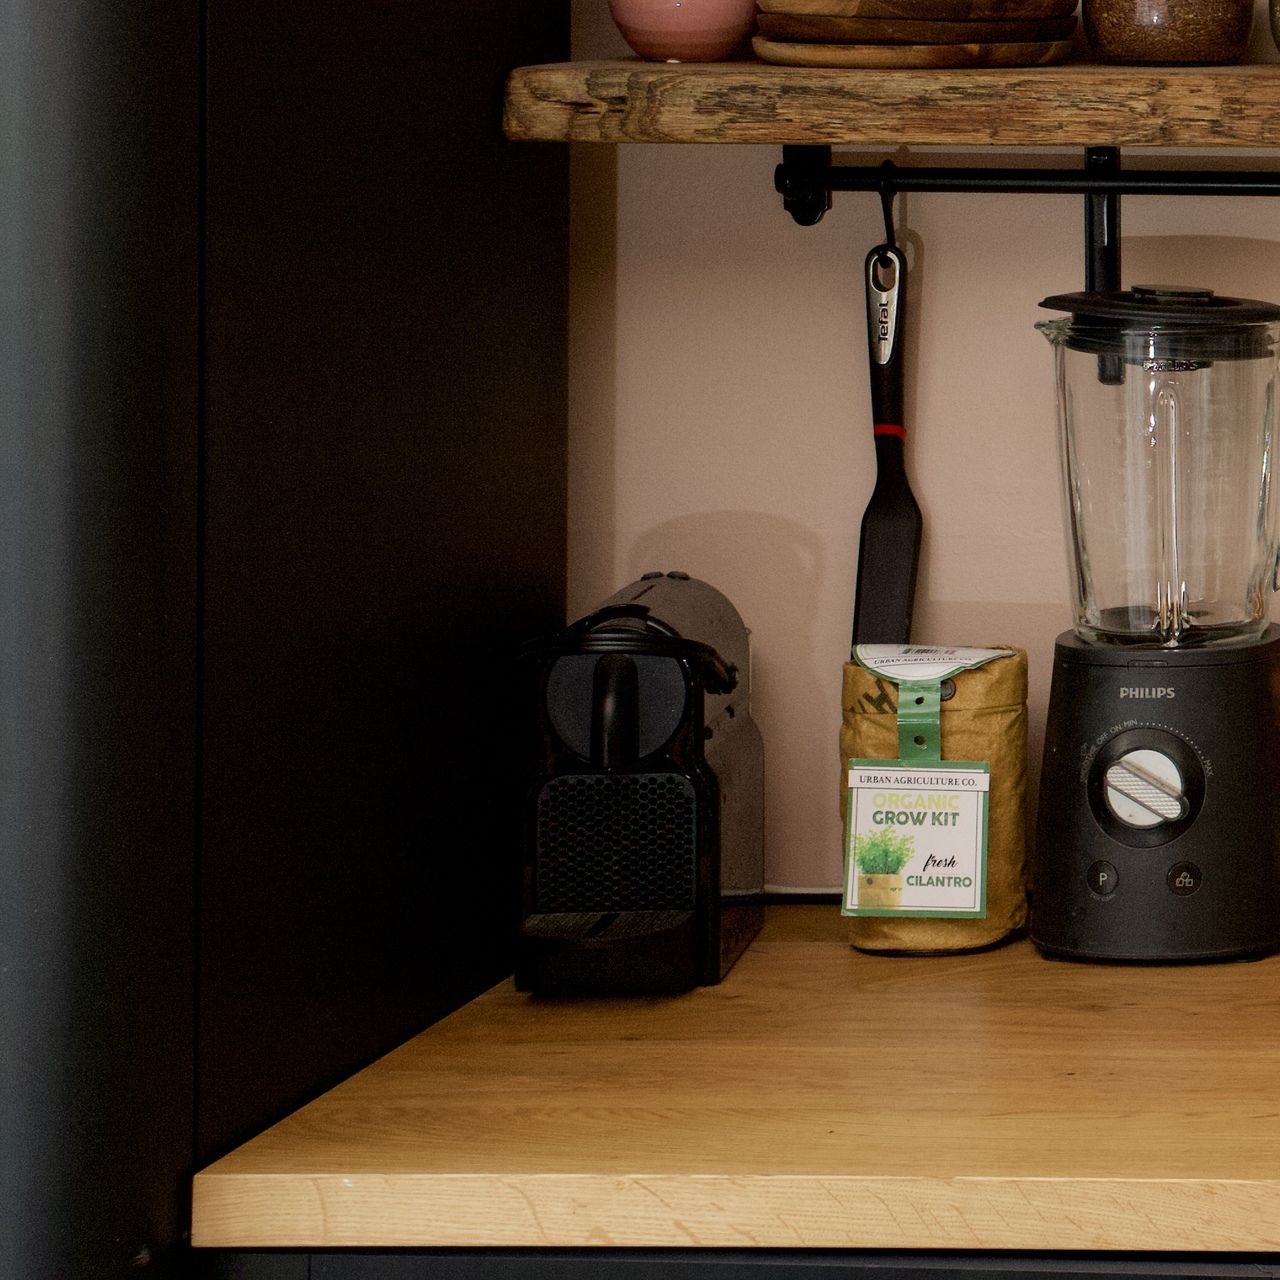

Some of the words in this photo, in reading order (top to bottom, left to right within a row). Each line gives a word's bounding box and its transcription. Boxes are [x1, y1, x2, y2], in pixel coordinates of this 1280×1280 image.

[878, 300, 889, 344] Tefal
[1119, 687, 1176, 699] PHILIPS
[1096, 732, 1108, 745] OFF
[1110, 724, 1123, 734] ON
[1123, 718, 1138, 728] MIN
[1202, 759, 1215, 777] MAX
[859, 775, 892, 784] URBAN
[893, 777, 960, 786] AGRICULTURE
[961, 779, 978, 787] CO.
[872, 792, 960, 810] ORGANIC
[872, 810, 928, 826] GROW
[931, 811, 960, 827] KIT
[922, 853, 958, 872] fresh
[1099, 872, 1108, 886] P
